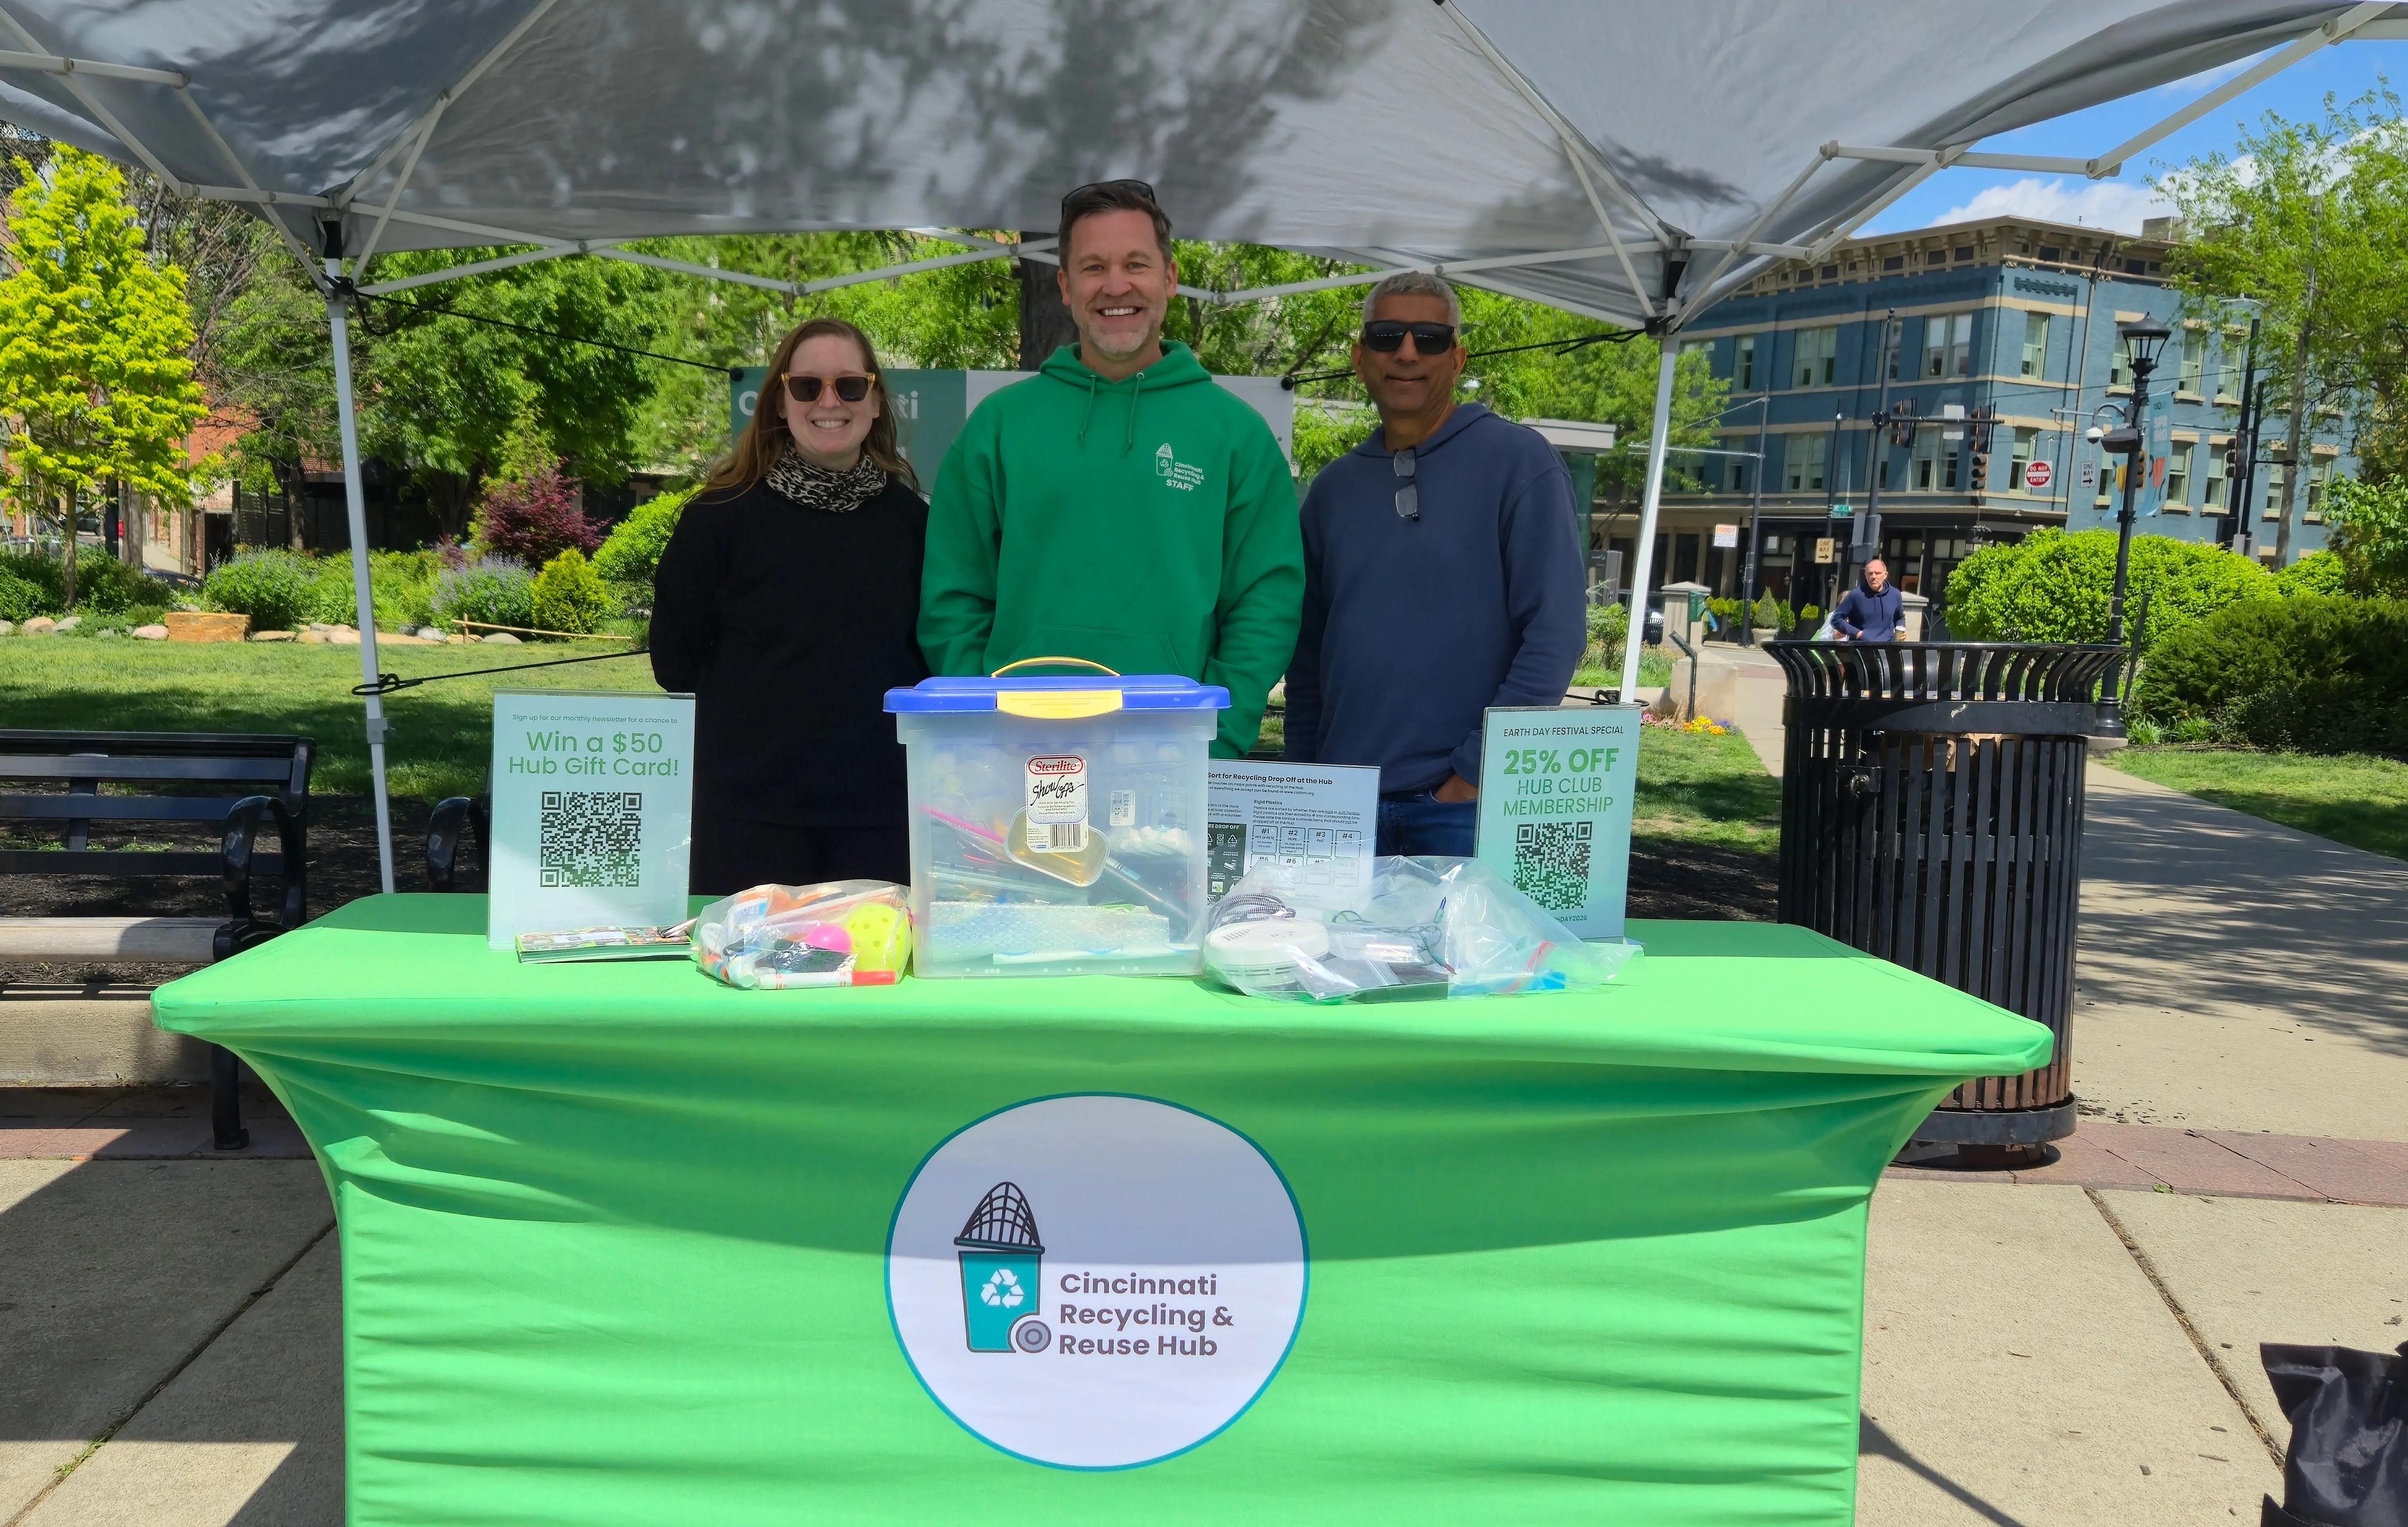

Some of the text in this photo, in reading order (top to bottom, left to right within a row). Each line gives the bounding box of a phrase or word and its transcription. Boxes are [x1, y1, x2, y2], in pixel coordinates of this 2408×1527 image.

[1174, 467, 1200, 480] Recycling
[1175, 462, 1203, 473] Cincinnati
[1166, 479, 1194, 491] STAFF
[1504, 728, 1530, 737] EARTH
[1552, 727, 1588, 735] FESTIVAL
[1591, 726, 1624, 734] SPECIAL
[527, 730, 663, 754] Win a $50
[510, 756, 678, 776] Hub Gift Card!
[1035, 760, 1076, 771] Sterilite
[1504, 748, 1619, 774] 25% OFF
[1233, 774, 1267, 782] Recycling
[1517, 777, 1602, 795] HUB CLUB
[1504, 796, 1613, 816] MEMBERSHIP
[1060, 1271, 1217, 1295] Cincinnati
[1060, 1302, 1234, 1332] Recycling &
[1059, 1335, 1217, 1356] Reuse Hub
